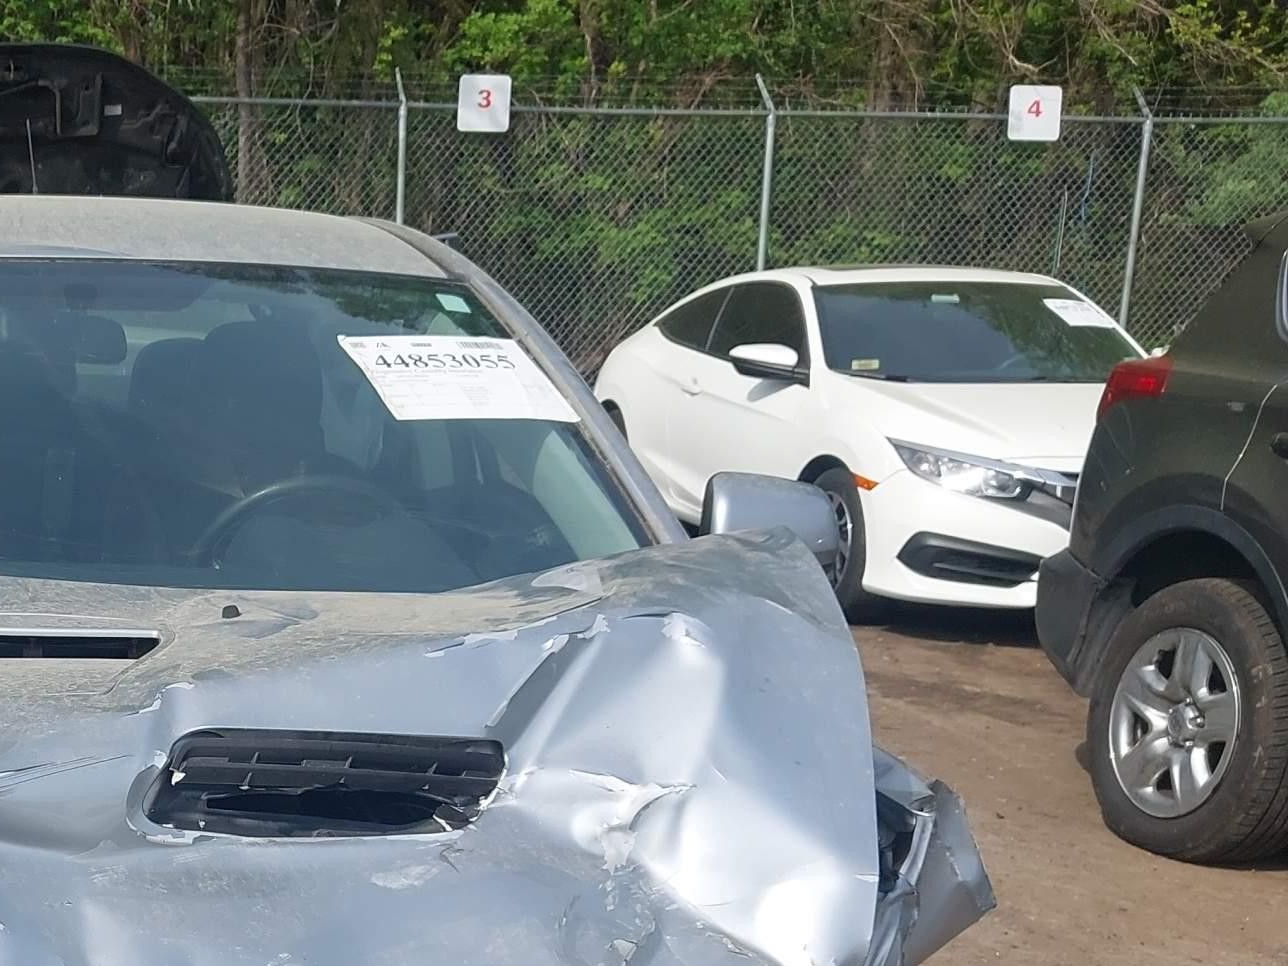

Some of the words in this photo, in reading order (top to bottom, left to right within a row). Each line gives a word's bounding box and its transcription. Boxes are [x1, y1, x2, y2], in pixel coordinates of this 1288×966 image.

[477, 89, 492, 109] 3
[1027, 99, 1043, 118] 4
[375, 353, 516, 369] 44853055
